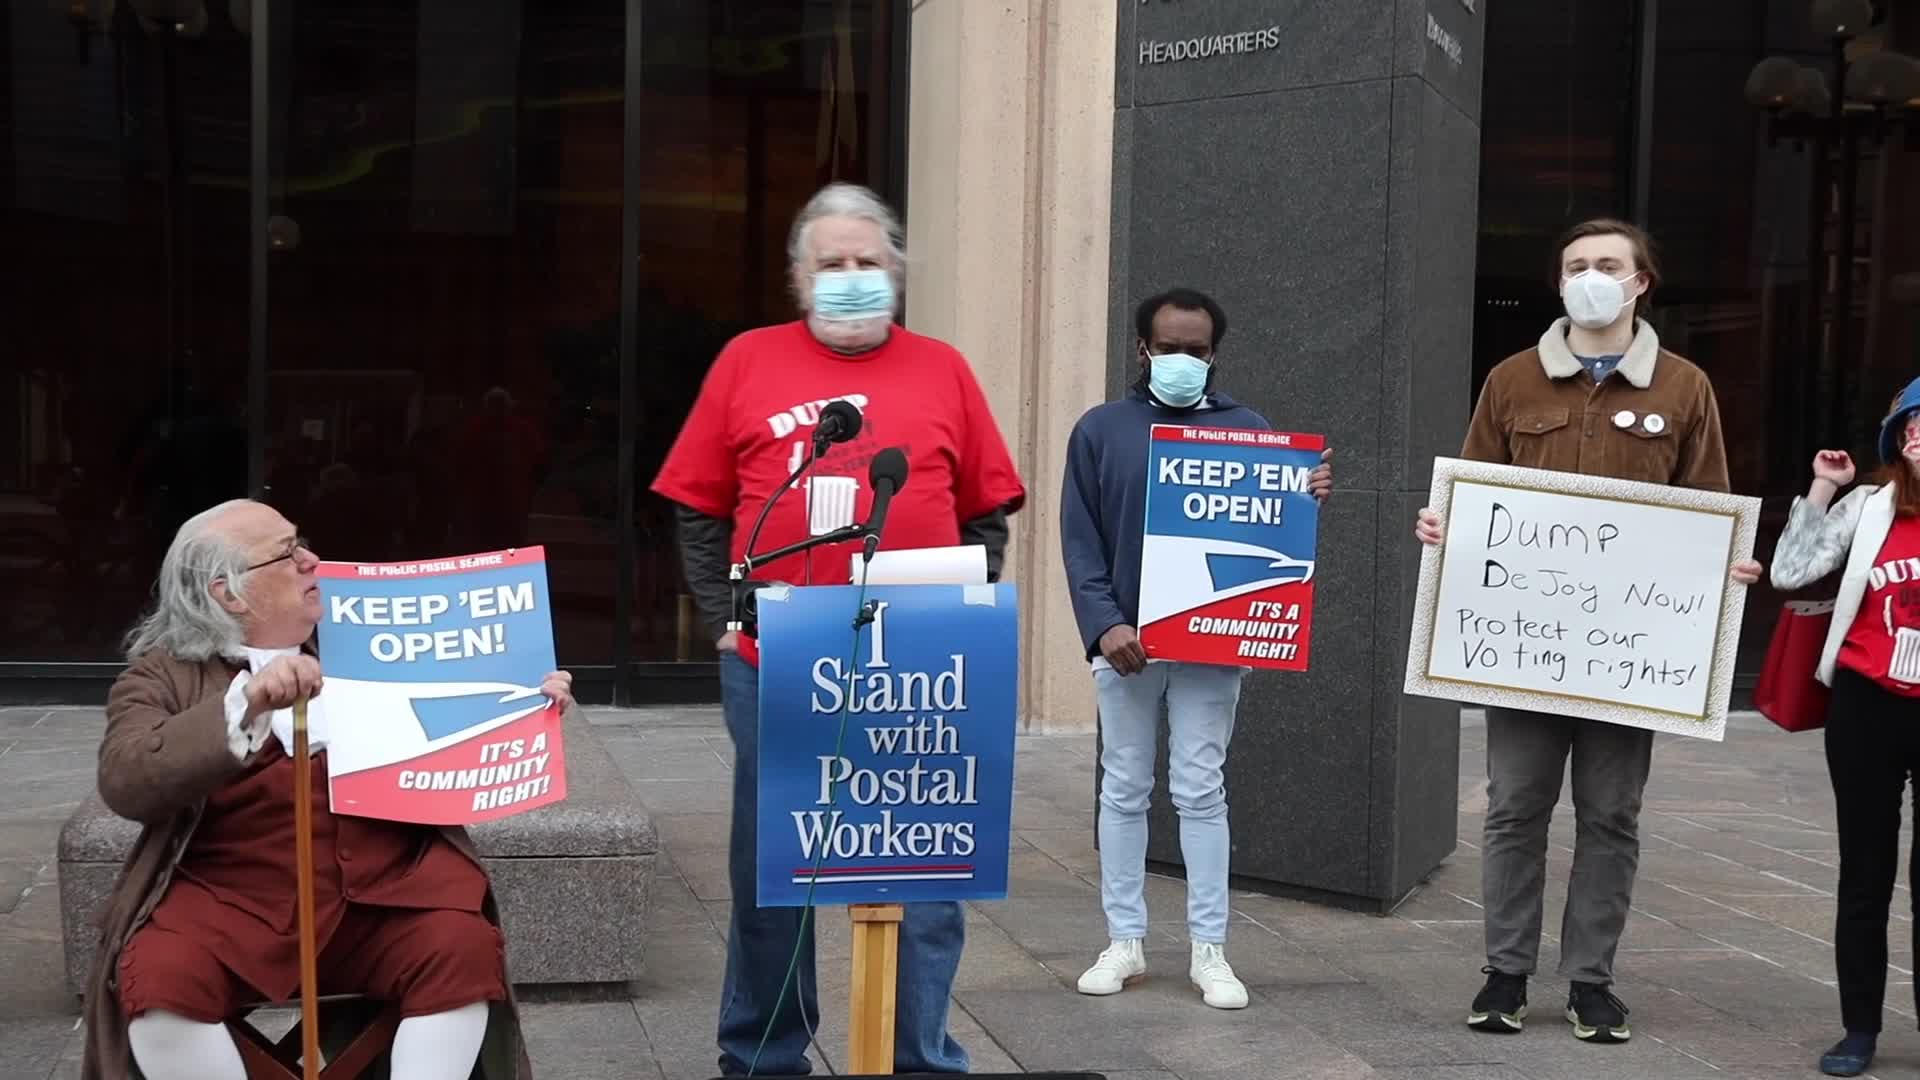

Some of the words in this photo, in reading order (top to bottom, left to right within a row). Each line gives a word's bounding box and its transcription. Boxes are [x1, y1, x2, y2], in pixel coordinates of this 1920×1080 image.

[1138, 26, 1281, 65] HEADQUARTERS
[767, 393, 869, 439] DUP
[1183, 428, 1197, 440] THE
[1198, 430, 1227, 441] PUBLIC
[1227, 431, 1256, 443] POSTAL
[1257, 434, 1291, 446] SERVICE
[1158, 457, 1245, 488] KEEP
[1253, 463, 1309, 493] 'EM
[1183, 492, 1283, 526] OPEN!
[1487, 502, 1619, 554] Dump
[357, 565, 378, 576] THE
[379, 564, 417, 576] PUBLIC
[419, 560, 457, 574] POSTAL
[459, 553, 504, 570] SERVICE
[330, 594, 449, 625] KEEP
[458, 581, 535, 619] 'EM
[1248, 600, 1283, 619] IT'S
[1285, 603, 1300, 621] A
[369, 623, 505, 663] OPEN!
[865, 600, 890, 668] I
[1188, 615, 1300, 641] COMMUNITY
[1457, 608, 1569, 642] Protect
[1586, 628, 1649, 650] our
[1237, 639, 1298, 661] RIGHT!
[811, 654, 968, 715] Stand
[479, 738, 525, 764] IT'S
[531, 731, 547, 753] A
[864, 715, 961, 756] with
[398, 752, 552, 791] COMMUNITY
[815, 755, 980, 806] Postal
[471, 774, 551, 812] RIGHT!
[790, 809, 976, 860] Workers
